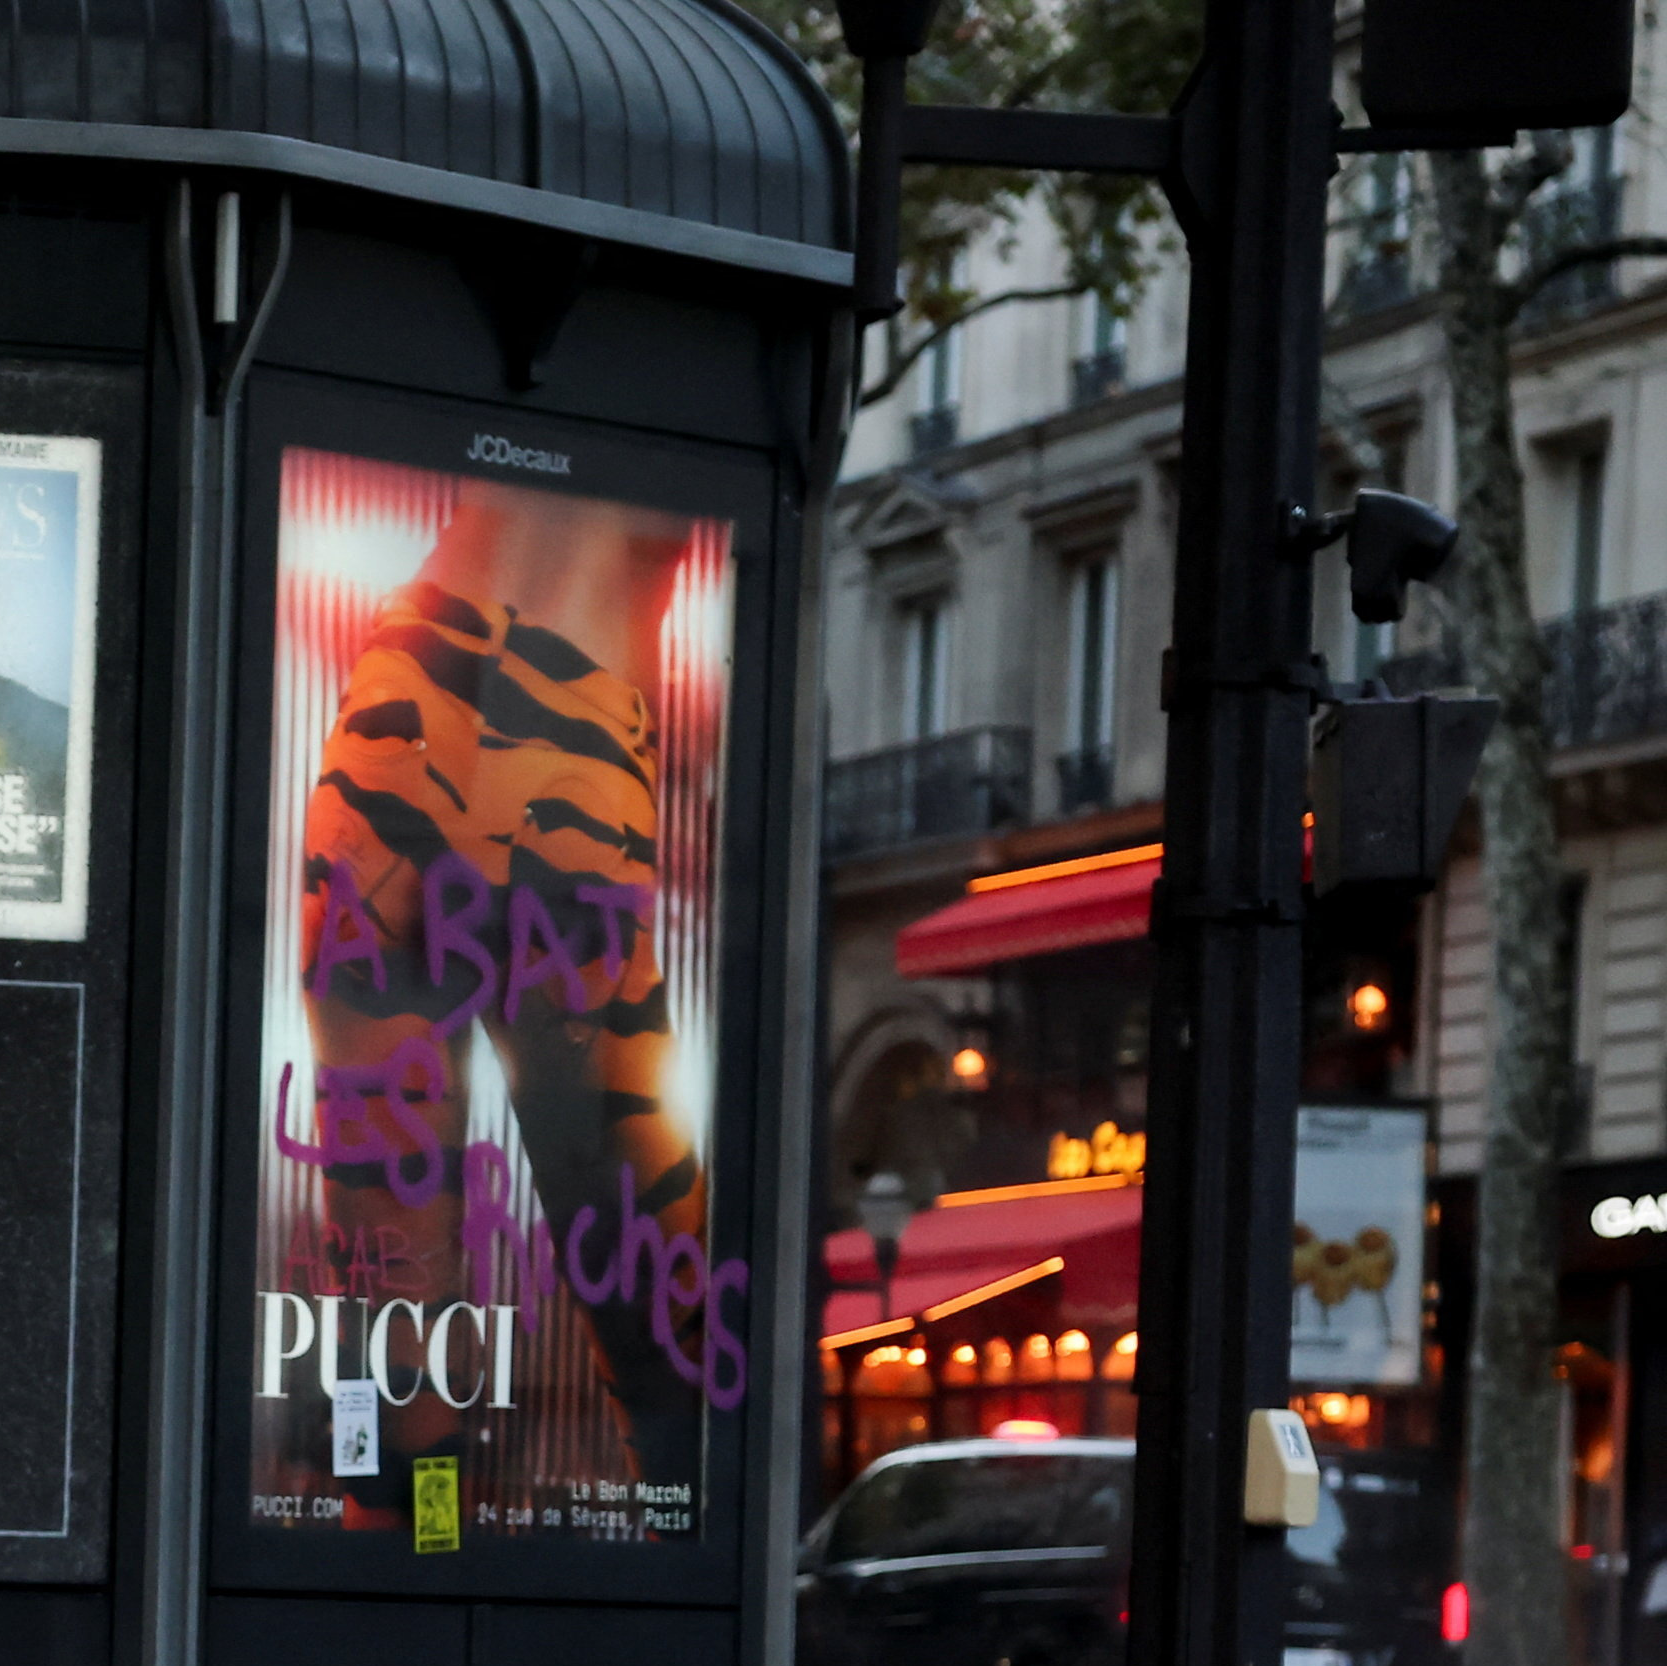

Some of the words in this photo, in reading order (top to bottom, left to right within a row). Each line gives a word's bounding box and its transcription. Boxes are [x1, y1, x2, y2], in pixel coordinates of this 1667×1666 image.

[467, 433, 571, 475] JCDecaux
[421, 849, 656, 1041] BAT
[276, 1037, 444, 1208] LES
[281, 1211, 432, 1298] ACAB
[254, 1291, 518, 1410] PUCCI
[252, 1494, 345, 1521] PUCCI.COM
[506, 1506, 534, 1527] rue
[542, 1506, 563, 1527] de
[643, 1506, 692, 1531] Paris
[571, 1480, 592, 1501] Le
[597, 1479, 628, 1502] Bon
[635, 1481, 692, 1505] Marché
